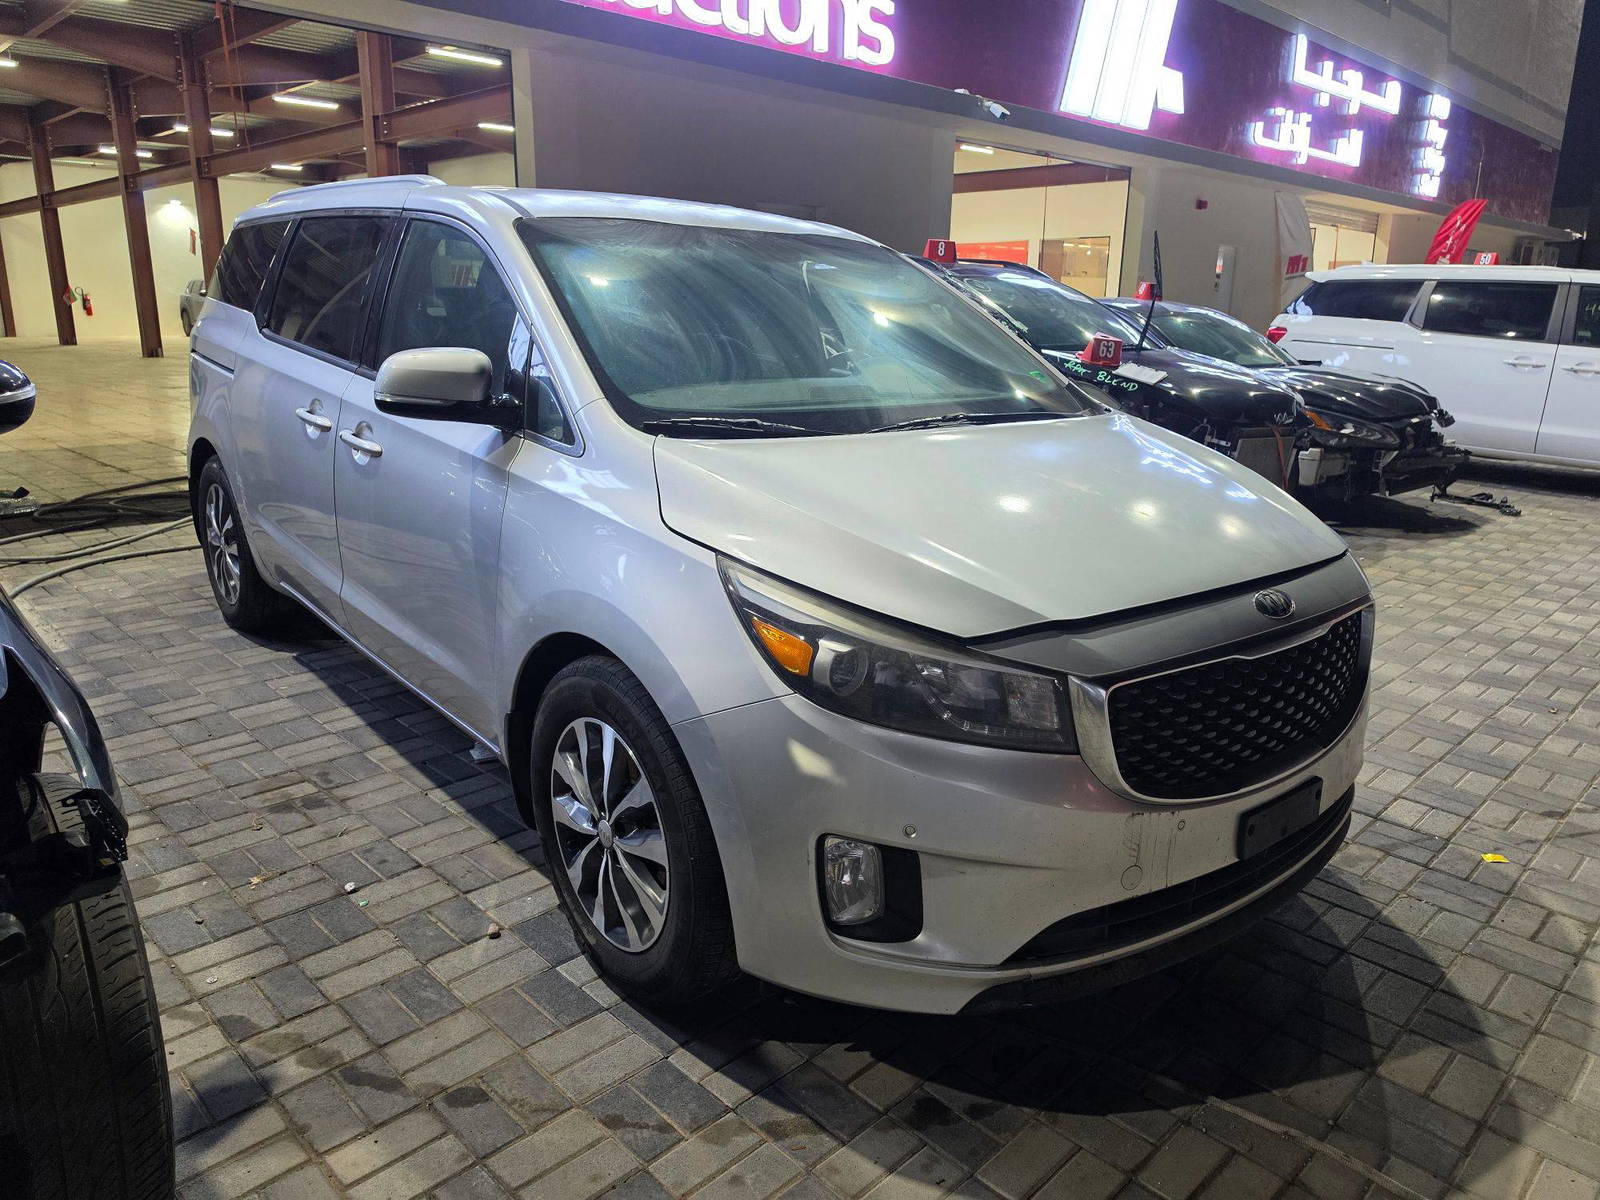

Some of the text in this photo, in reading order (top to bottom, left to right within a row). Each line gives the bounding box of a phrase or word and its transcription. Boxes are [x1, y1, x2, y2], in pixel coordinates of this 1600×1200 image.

[938, 242, 945, 256] 8
[1099, 341, 1115, 358] 63
[1096, 370, 1138, 391] BLEND
